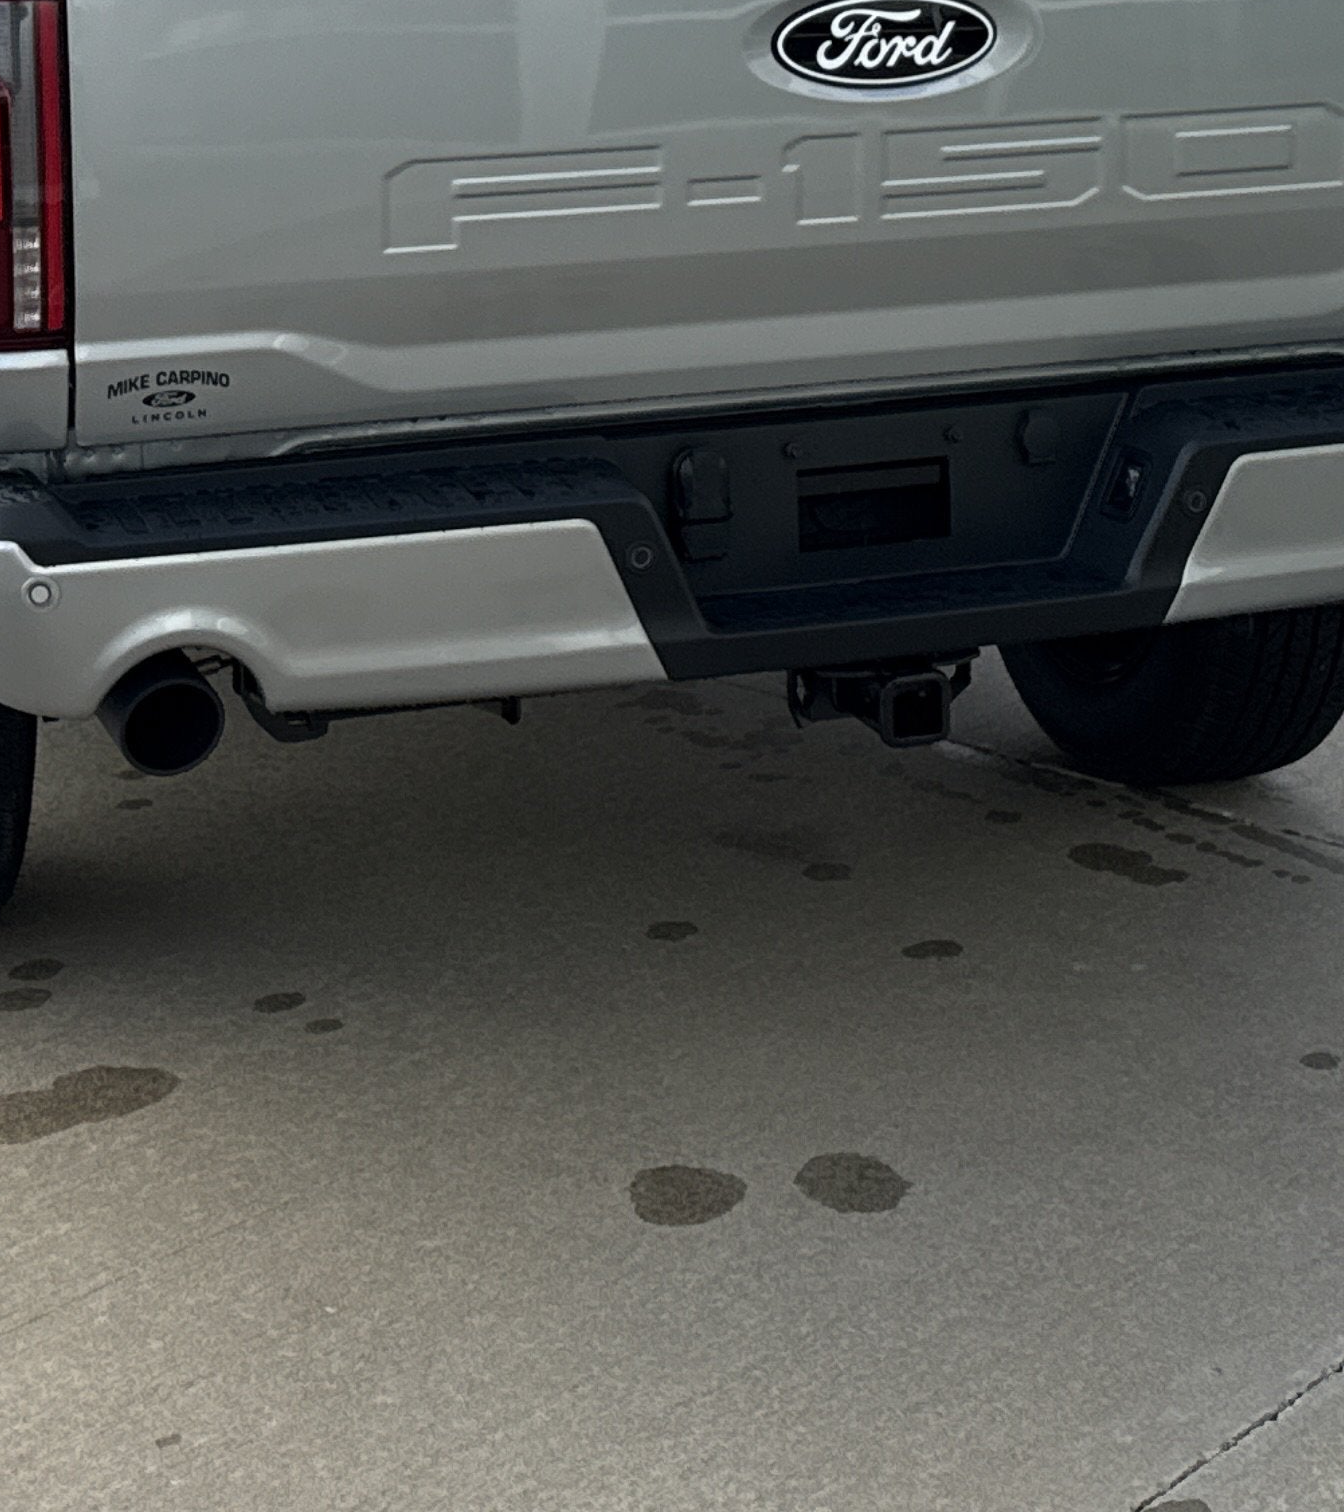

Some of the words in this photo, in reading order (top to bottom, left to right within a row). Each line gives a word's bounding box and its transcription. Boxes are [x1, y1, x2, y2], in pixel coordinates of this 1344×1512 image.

[816, 8, 955, 70] Ford
[107, 374, 150, 399] MIKE
[156, 370, 230, 387] CARPINO
[132, 409, 207, 424] LINCOLN
